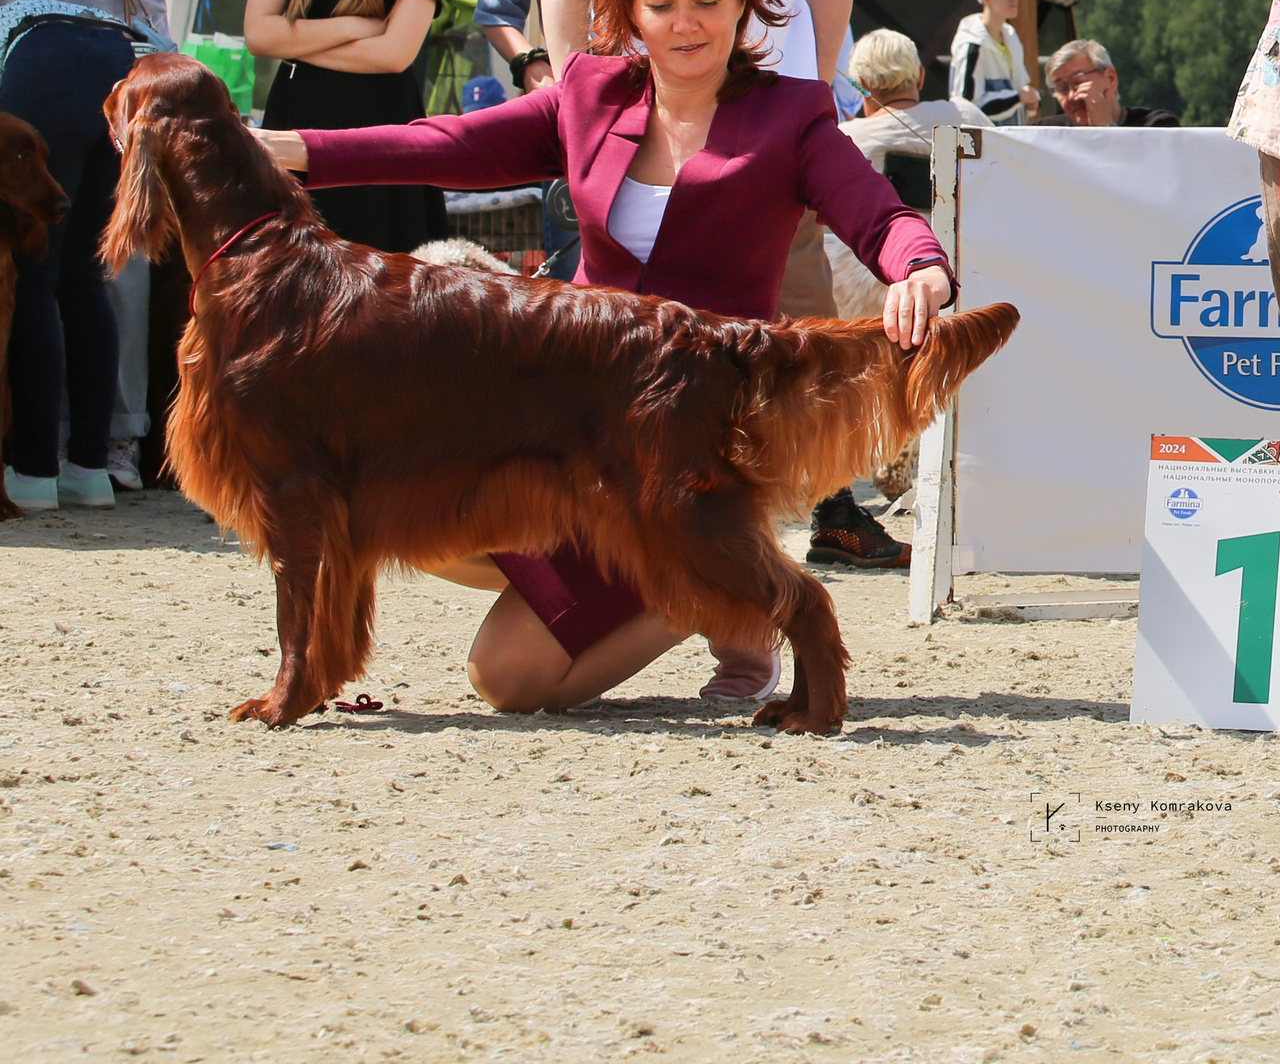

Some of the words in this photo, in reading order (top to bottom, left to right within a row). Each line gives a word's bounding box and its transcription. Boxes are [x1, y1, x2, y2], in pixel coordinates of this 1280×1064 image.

[1223, 351, 1261, 376] Pet
[1159, 444, 1186, 454] 2024
[1158, 464, 1228, 473] НАЦИОНАЛЬНЫЕ
[1230, 467, 1275, 475] ВЫСТАВКИ
[1163, 474, 1233, 483] НАЦИОНАЛЬНЫЕ
[1166, 498, 1201, 508] Farmina
